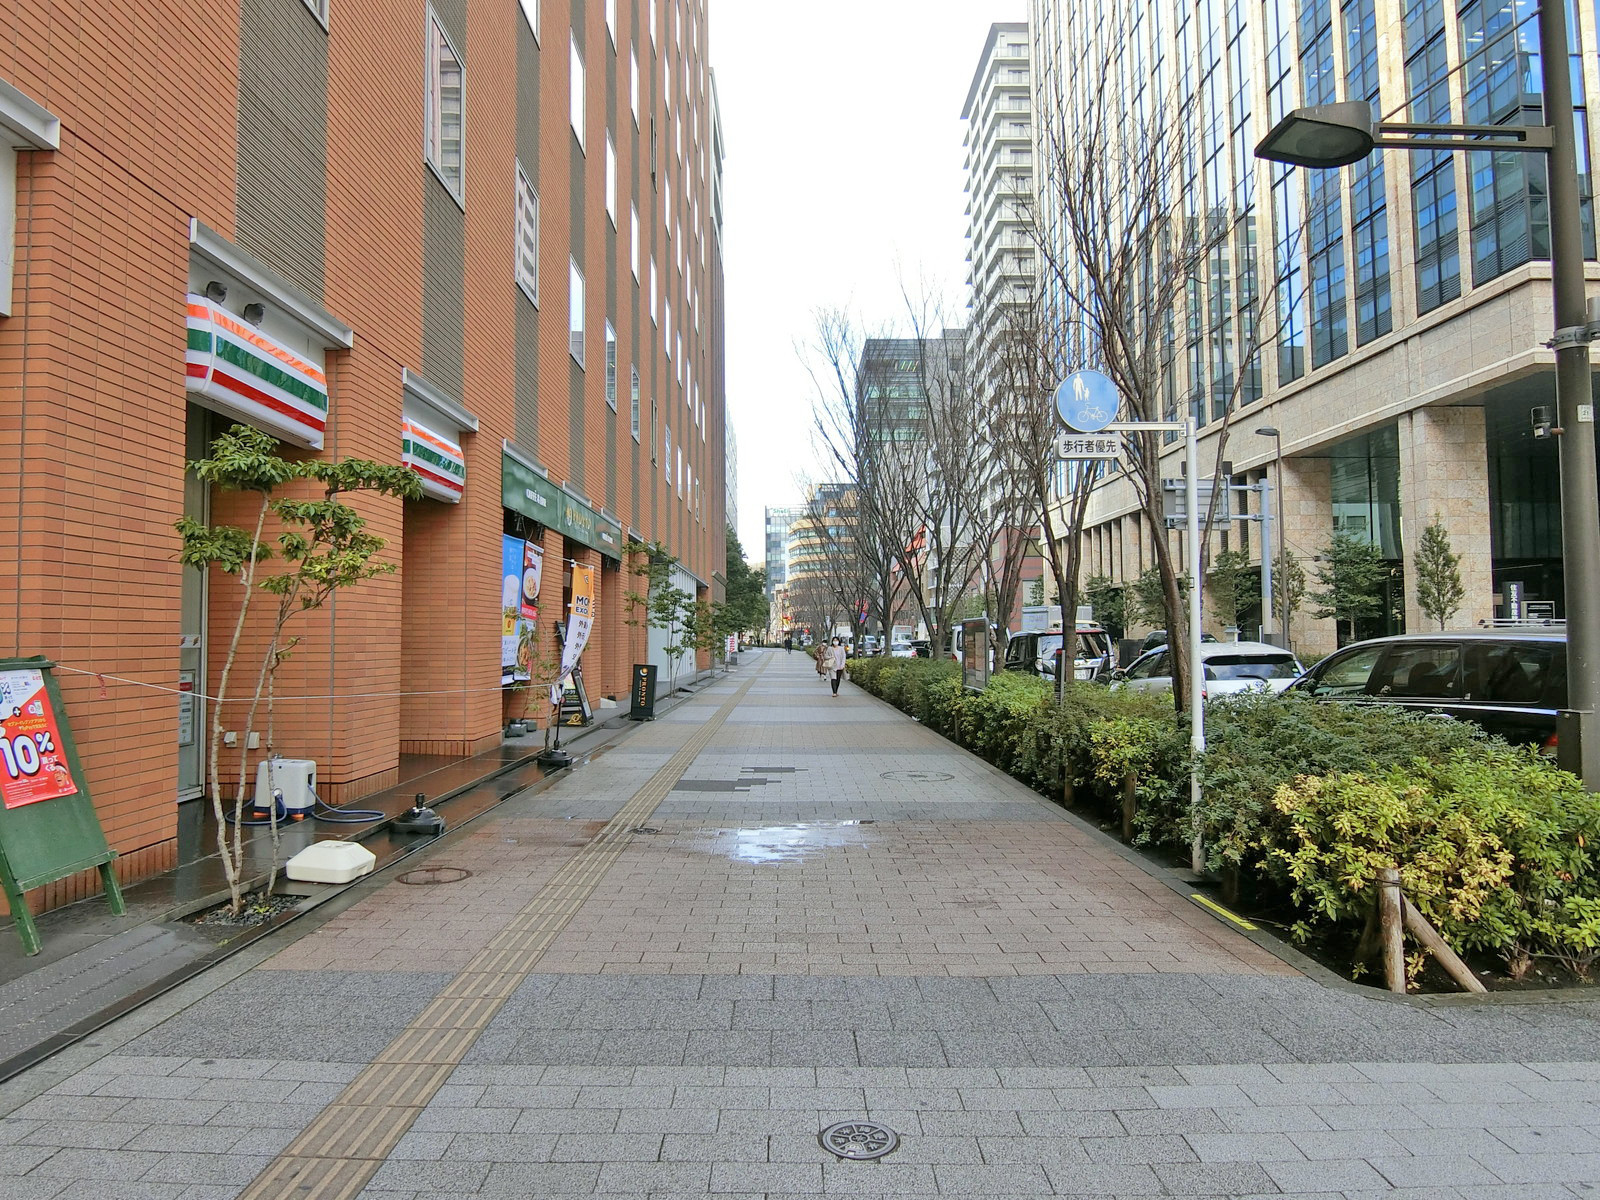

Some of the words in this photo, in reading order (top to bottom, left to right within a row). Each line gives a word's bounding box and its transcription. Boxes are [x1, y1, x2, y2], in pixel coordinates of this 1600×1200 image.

[1063, 439, 1117, 453] 歩行者優先
[640, 677, 648, 707] PRONTO
